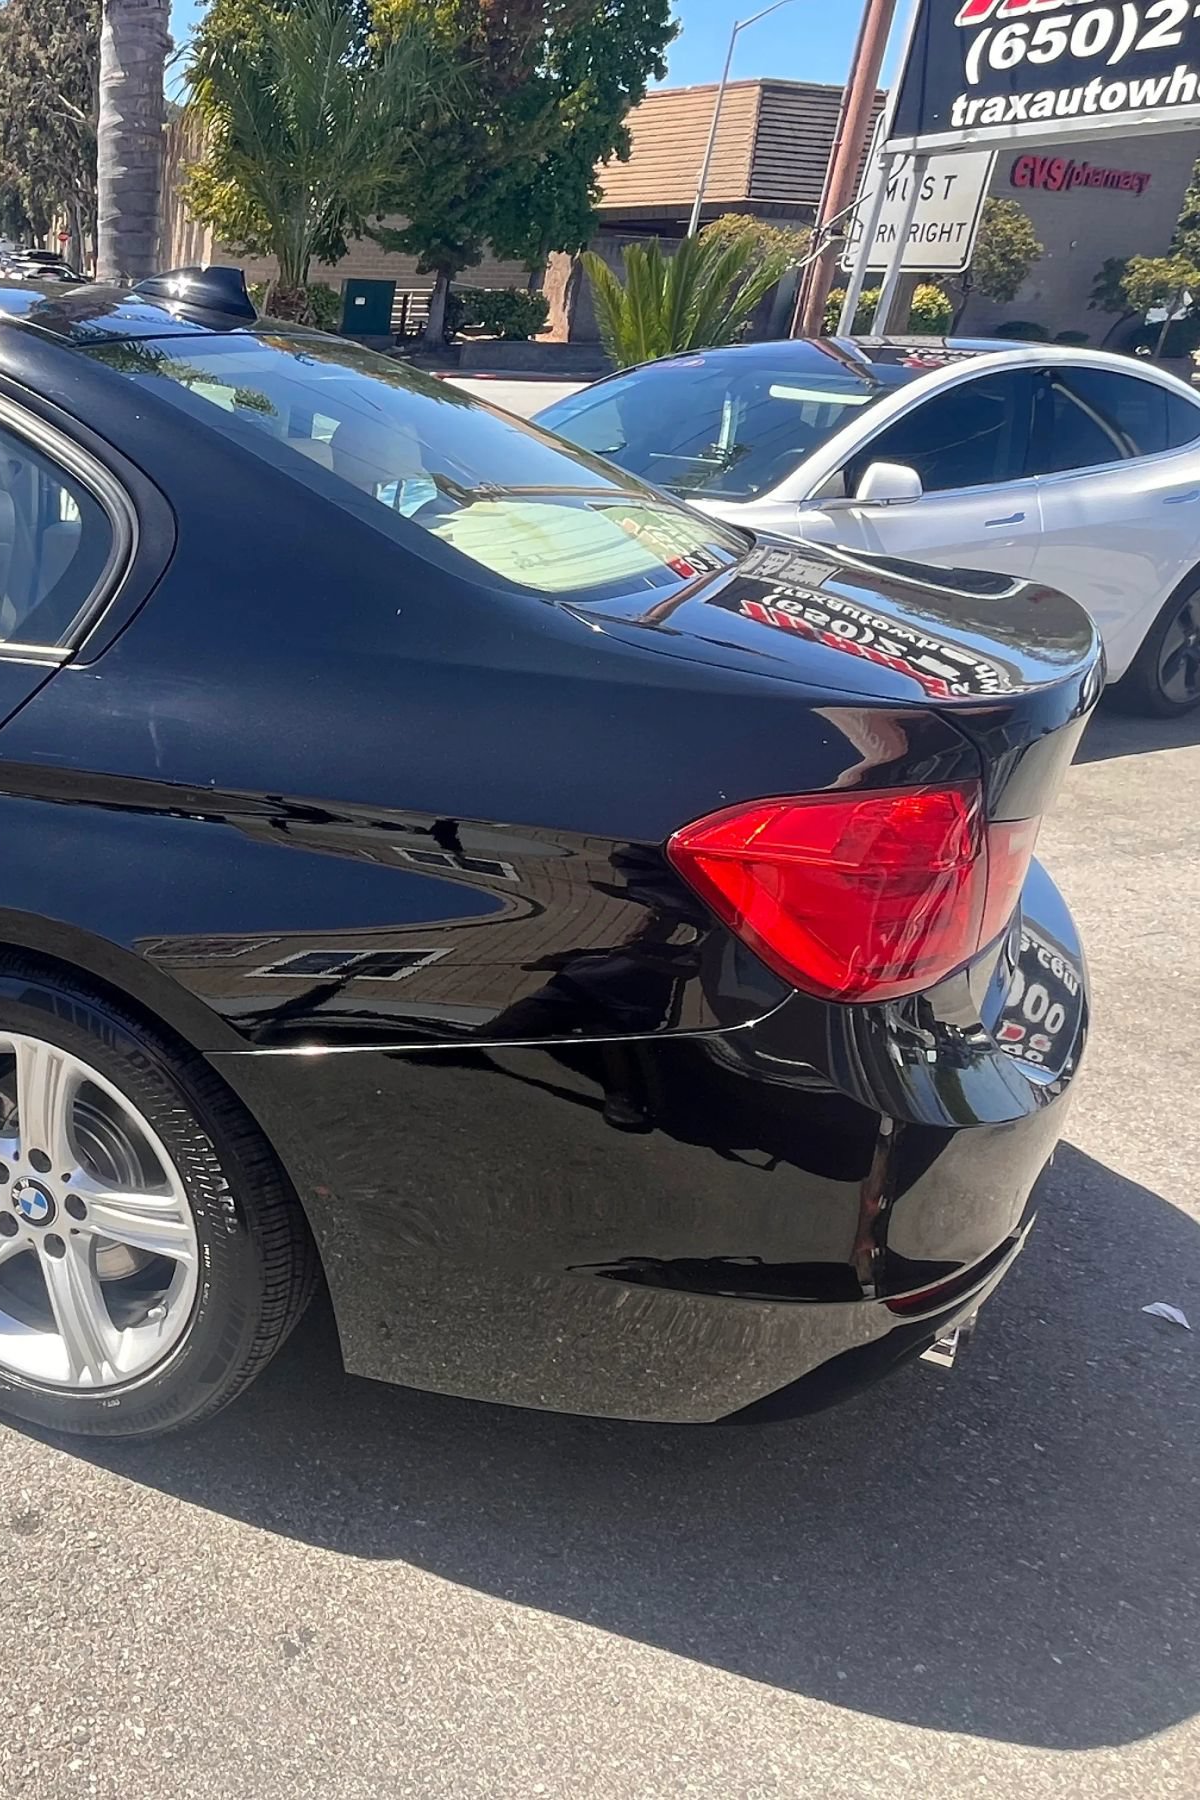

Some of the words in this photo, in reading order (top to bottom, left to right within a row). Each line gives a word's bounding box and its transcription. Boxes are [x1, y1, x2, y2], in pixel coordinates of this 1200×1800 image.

[965, 0, 1200, 84] (650)2
[951, 64, 1200, 127] traxautowh
[907, 222, 968, 243] RIGHT
